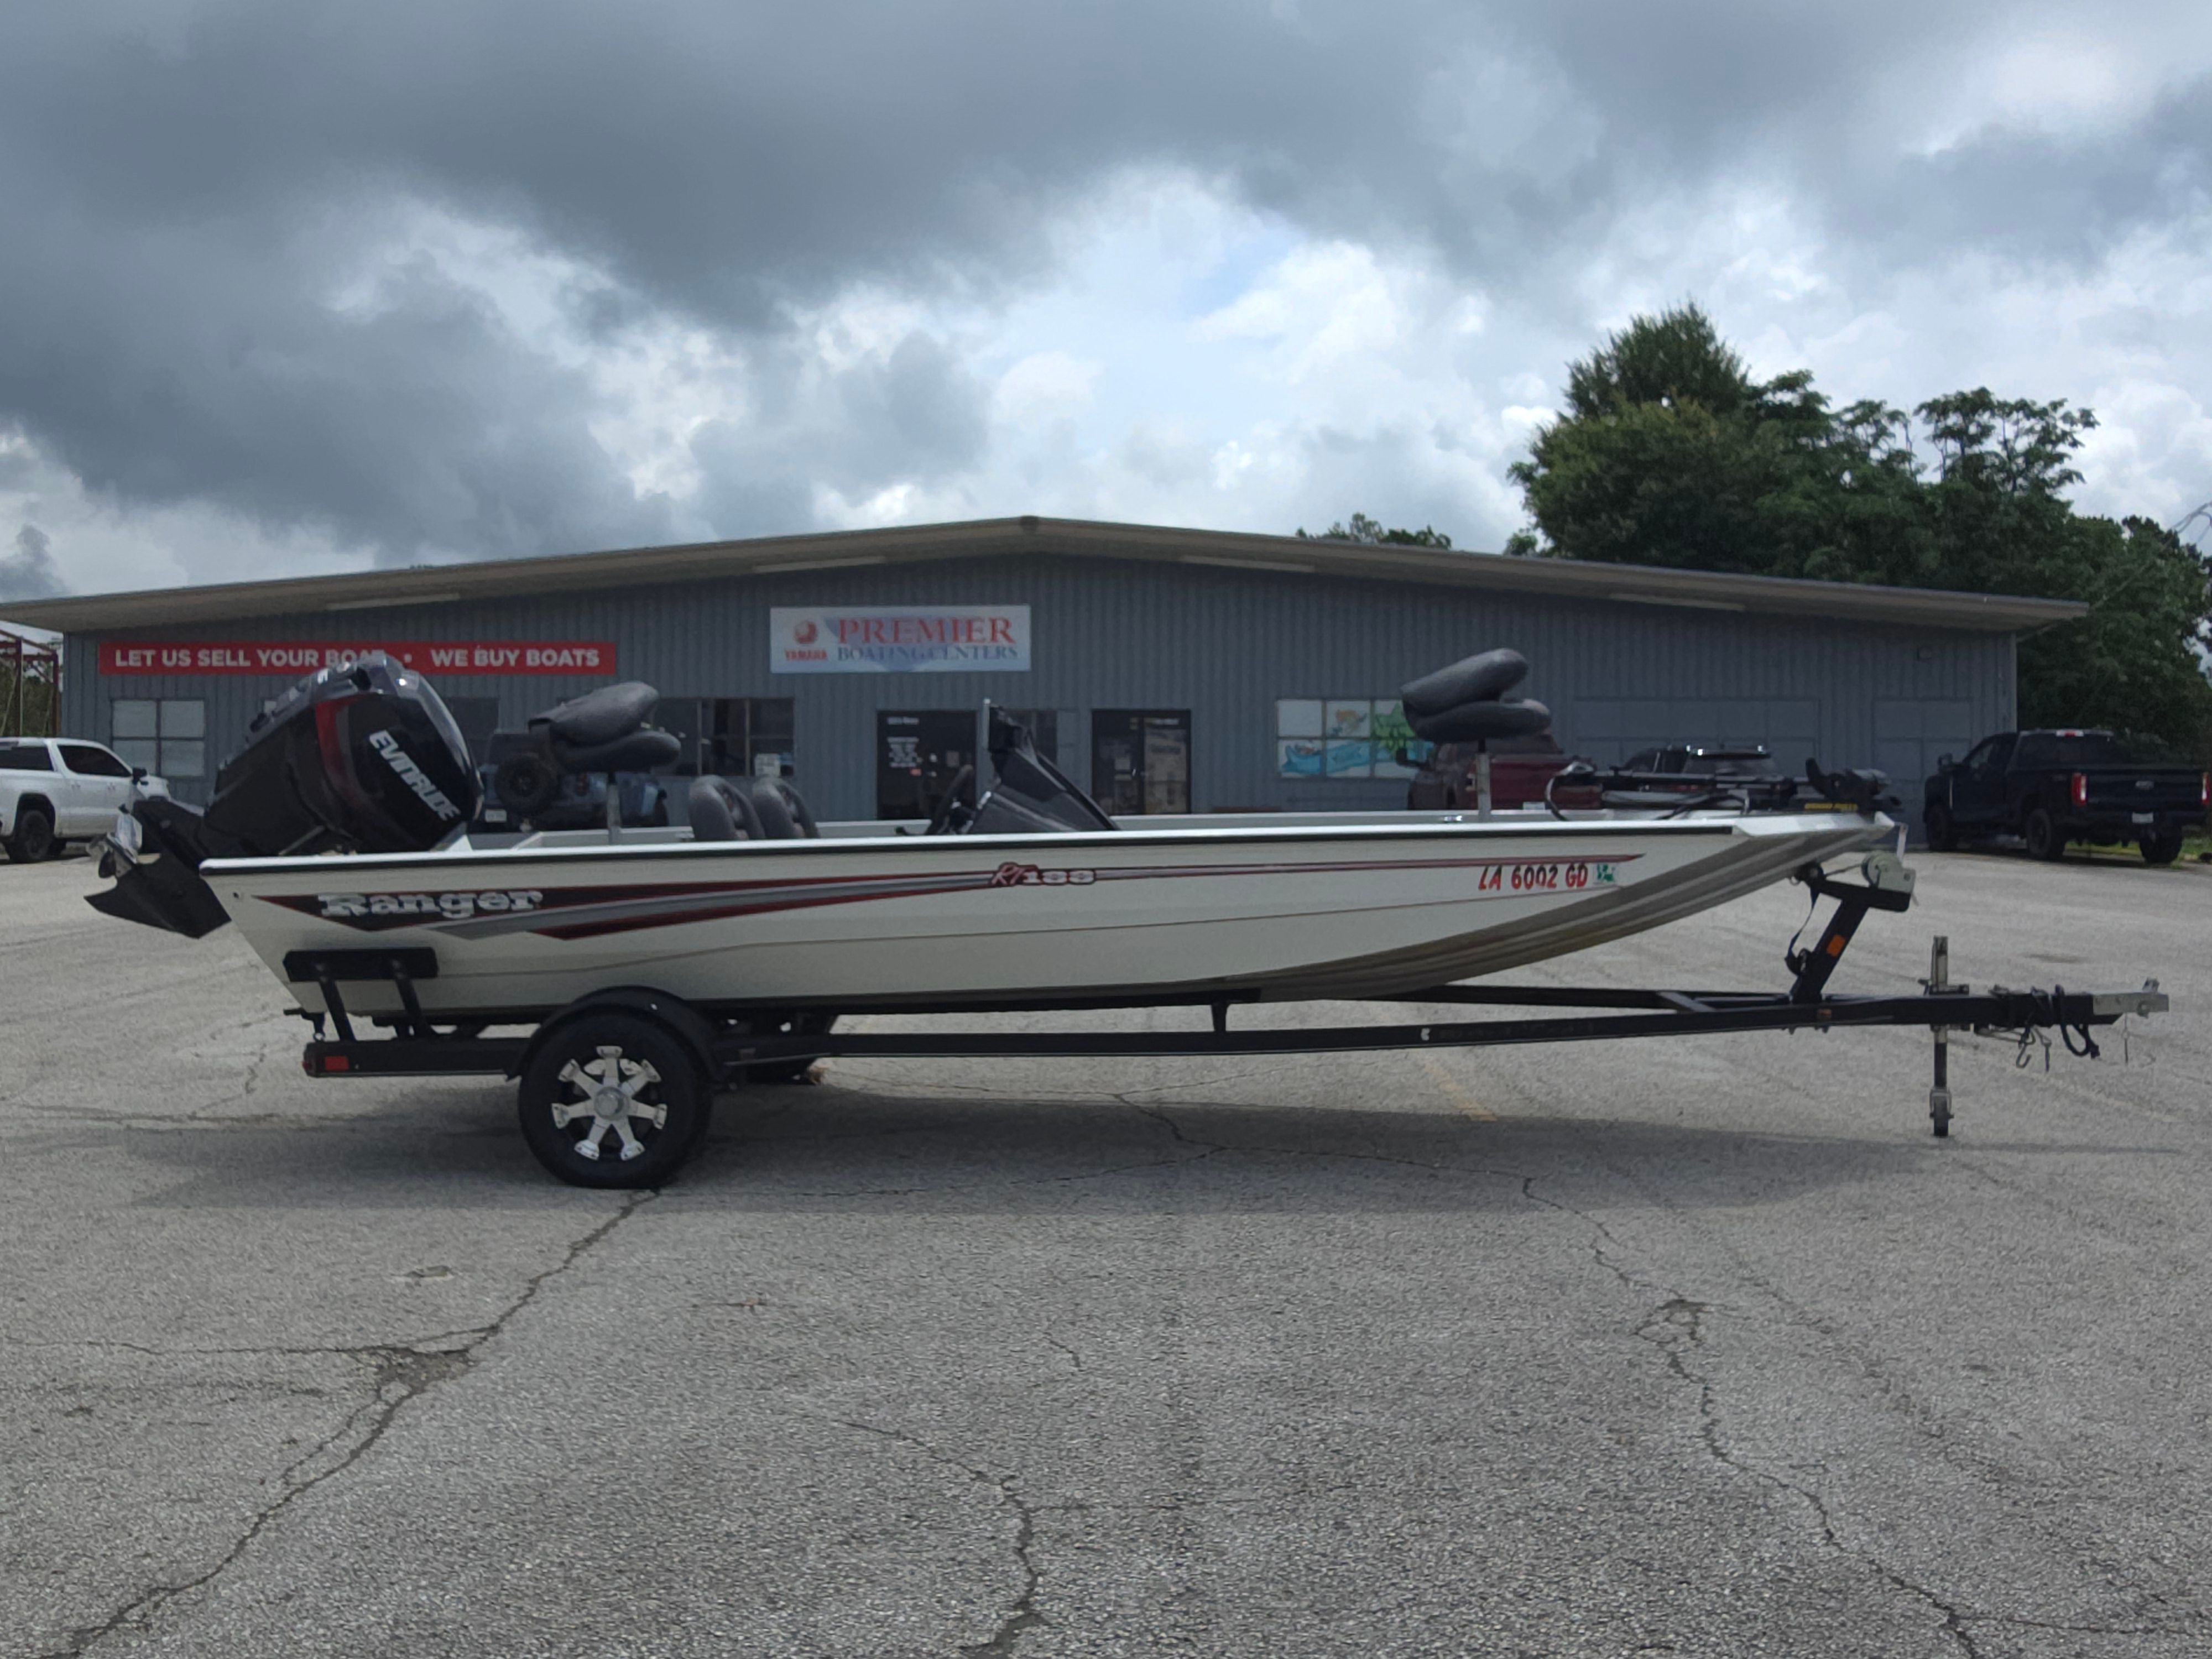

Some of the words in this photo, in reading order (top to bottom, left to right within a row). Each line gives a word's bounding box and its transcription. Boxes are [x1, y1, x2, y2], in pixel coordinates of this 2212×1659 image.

[838, 617, 1016, 644] PREMIER
[115, 649, 156, 667] LET
[161, 649, 192, 667] US
[197, 649, 251, 667] SELL
[257, 649, 319, 667] YOUR
[325, 649, 384, 667] BO
[431, 649, 468, 667] WE
[474, 649, 520, 667] BUY
[526, 649, 599, 667] BOATS
[837, 646, 926, 661] BOATING
[369, 730, 462, 821] EVINRUDE
[1478, 865, 1502, 891] LA
[1511, 864, 1558, 890] 6002
[1565, 862, 1589, 888] GD
[317, 890, 544, 919] Ranger
